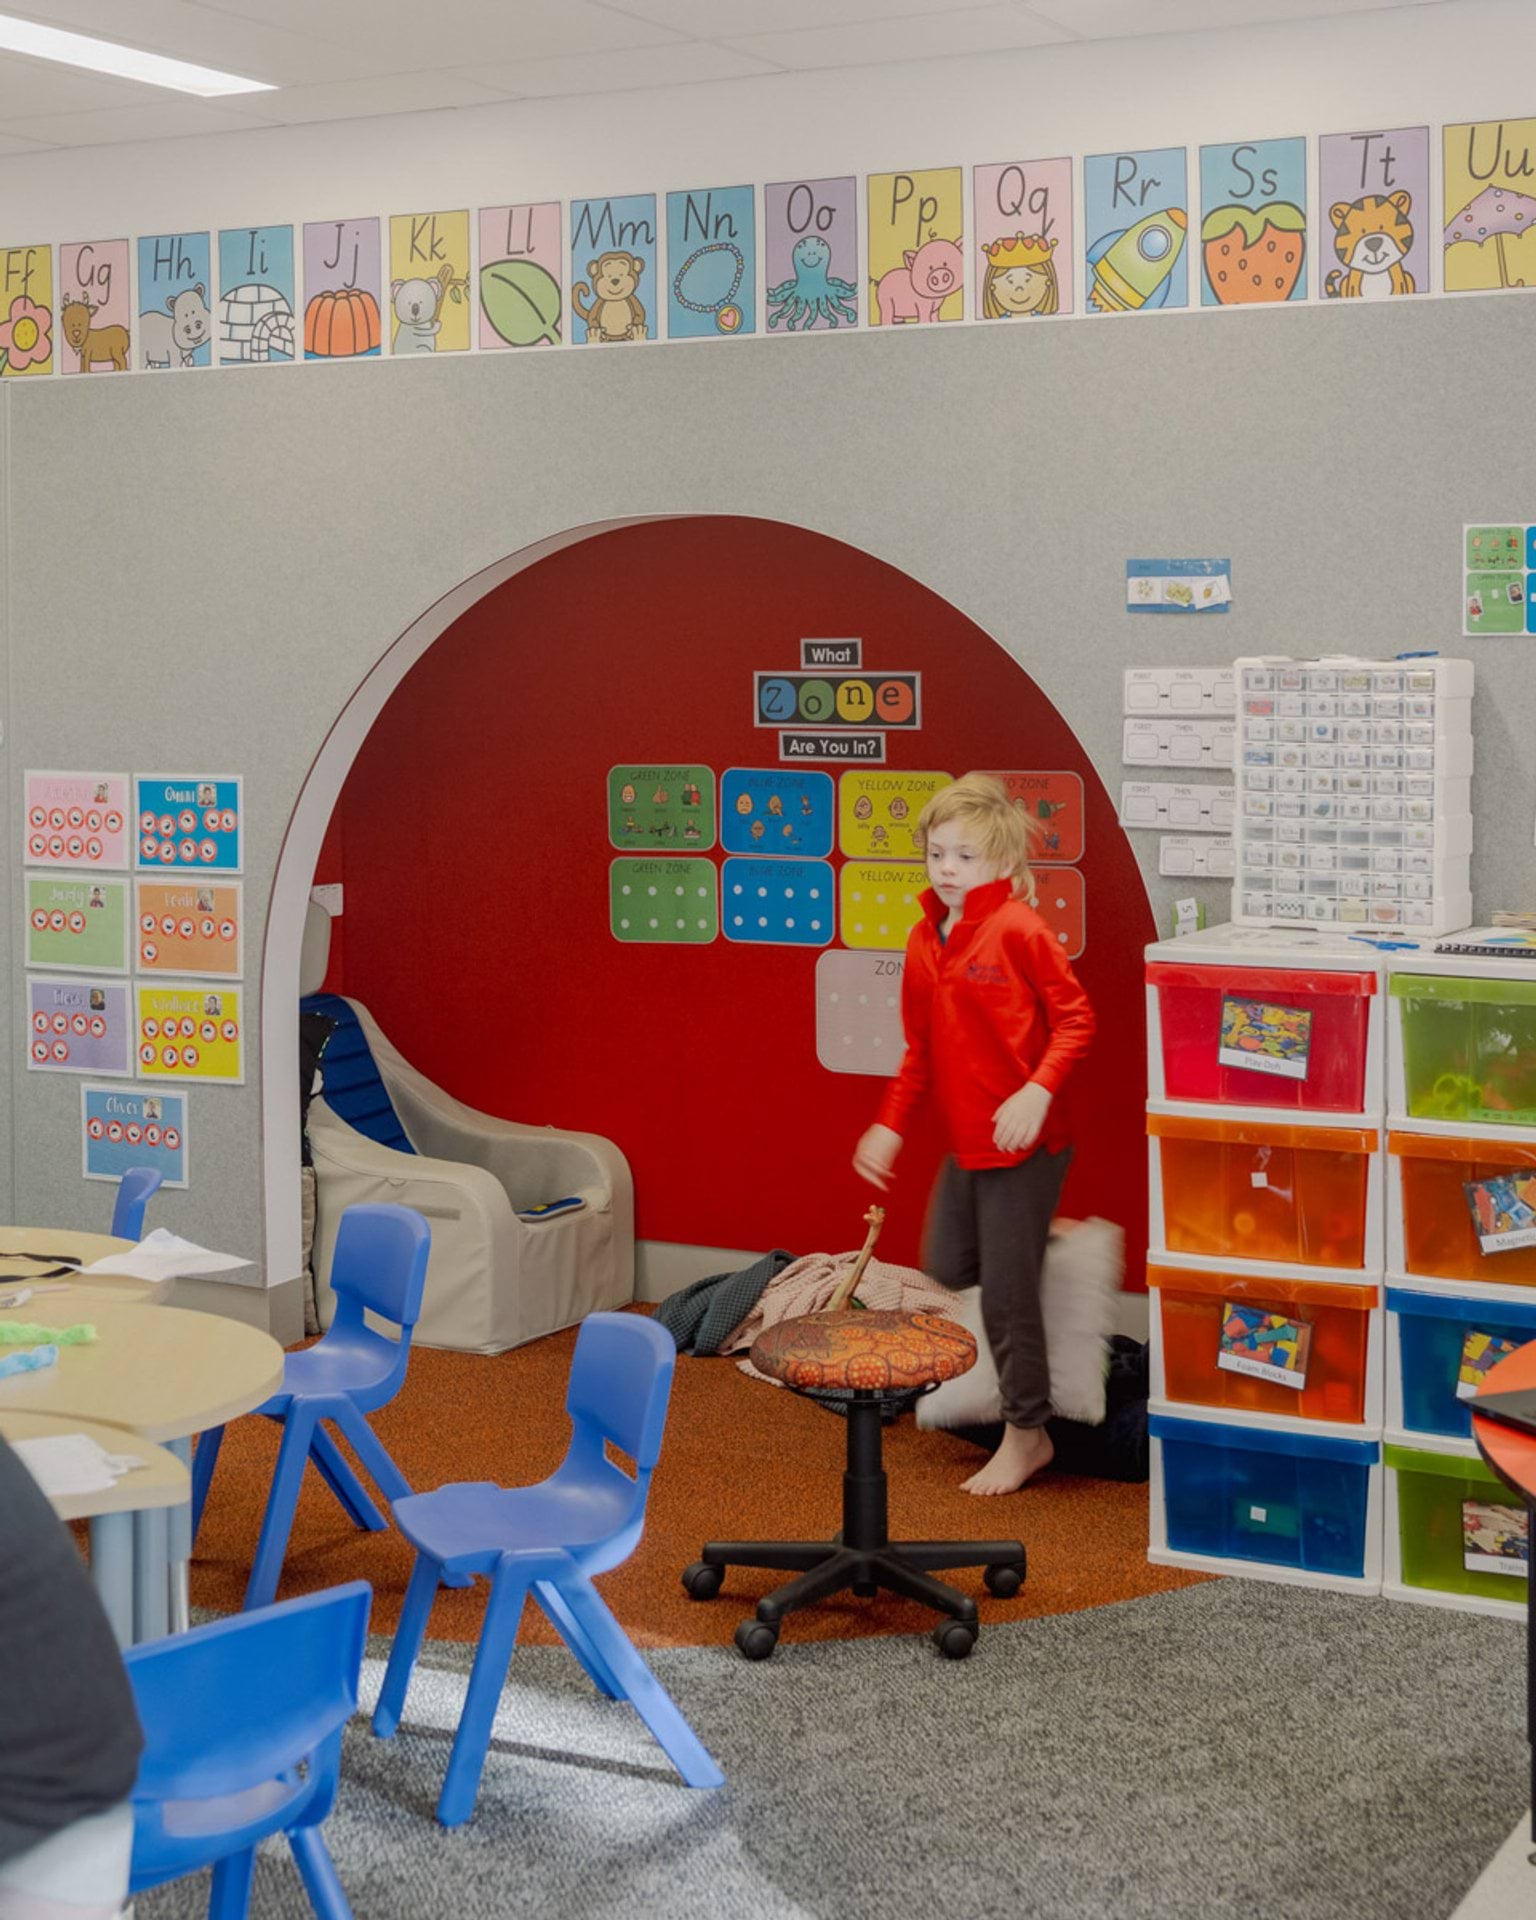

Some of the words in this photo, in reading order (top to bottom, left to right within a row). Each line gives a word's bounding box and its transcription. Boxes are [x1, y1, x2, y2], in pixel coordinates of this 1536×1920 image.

[1228, 146, 1278, 198] Ss
[1350, 134, 1396, 189] Tt
[1468, 124, 1535, 180] Uu
[997, 166, 1055, 236] Qq
[1113, 156, 1162, 208] Rr
[571, 201, 655, 250] Mm
[684, 192, 738, 242] Nn
[787, 184, 837, 233] Oo
[891, 175, 938, 248] Pp
[153, 237, 196, 282] Hh
[246, 230, 269, 276] Ii
[323, 223, 359, 289] Jj
[409, 216, 447, 263] Kk
[5, 249, 37, 310] Ff
[76, 245, 112, 305] Gg
[812, 648, 852, 663] What
[789, 739, 816, 754] Are
[819, 740, 849, 755] You
[853, 740, 877, 755] In?
[629, 770, 660, 781] GREEN
[663, 769, 690, 782] ZONE
[777, 777, 805, 789] ZONE
[858, 779, 904, 791] YELLOW
[907, 780, 936, 792] ZONE
[632, 863, 662, 874] GREEN
[664, 863, 693, 875] ZONE
[859, 870, 905, 882] YELLOW
[907, 872, 932, 883] ZON
